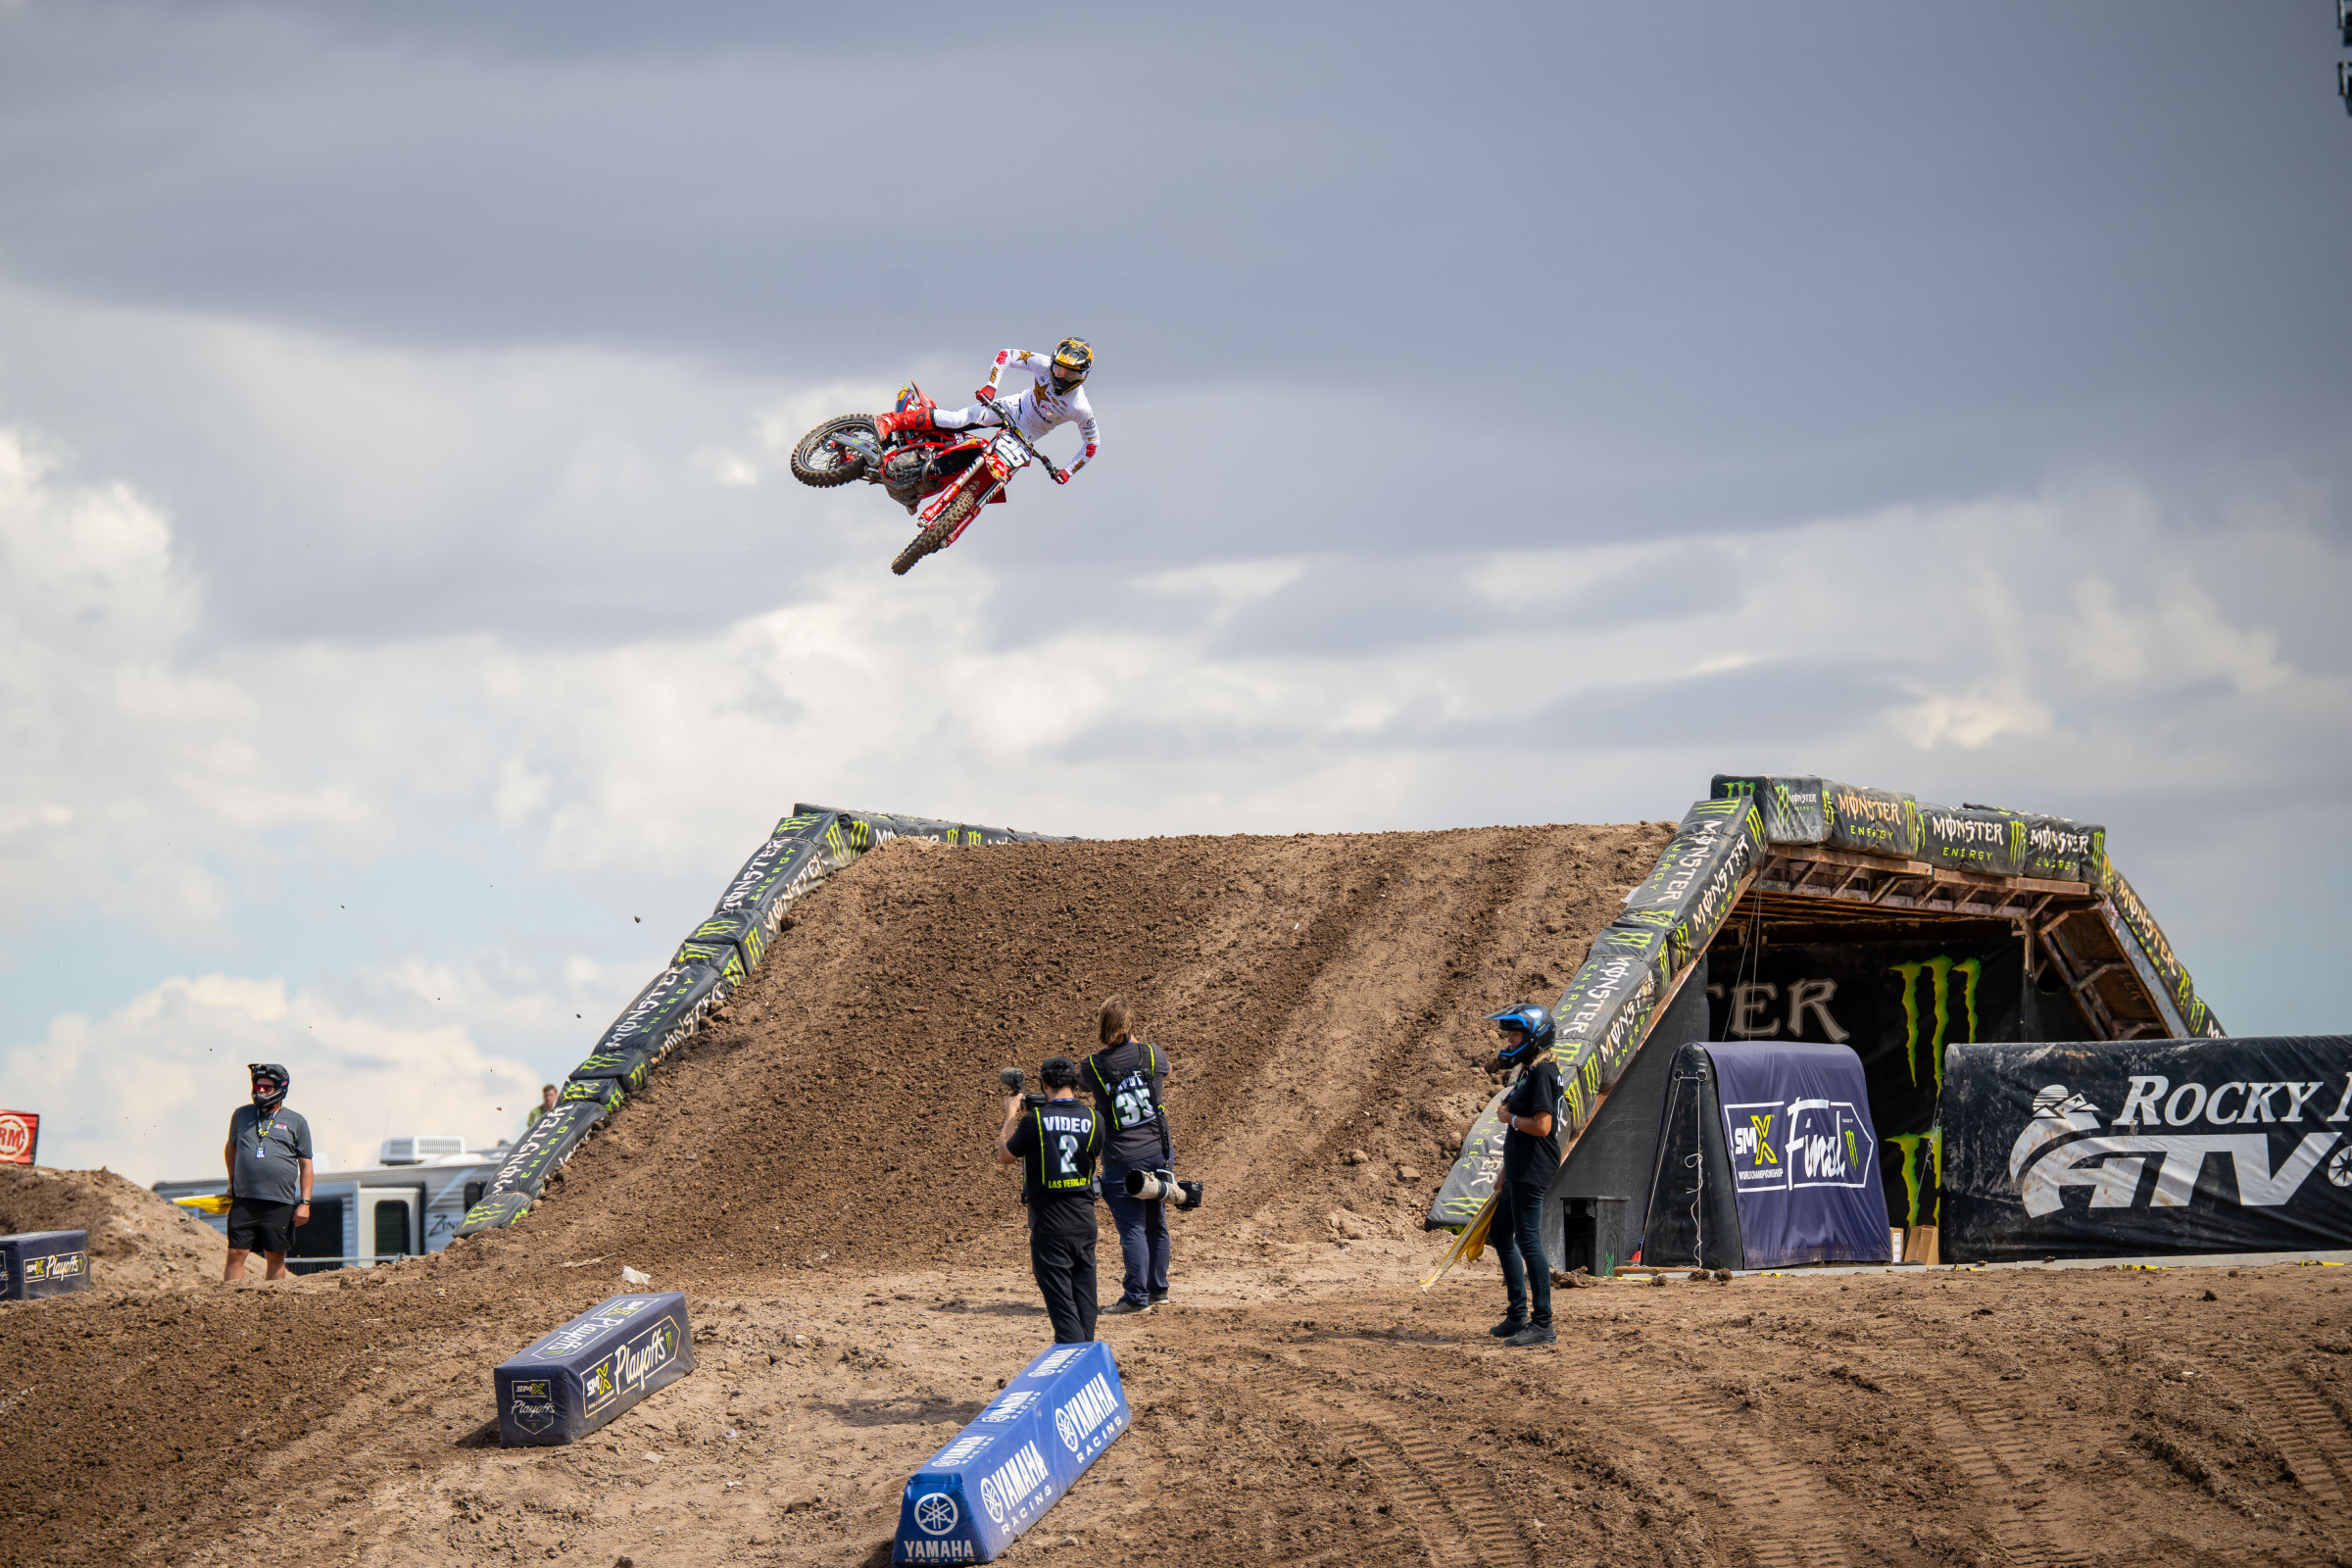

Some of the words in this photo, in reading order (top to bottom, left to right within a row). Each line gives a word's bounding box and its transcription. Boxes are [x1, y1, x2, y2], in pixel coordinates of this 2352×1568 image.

[996, 434, 1031, 467] 25
[1838, 792, 1901, 825] MONSTER
[1932, 813, 2004, 847] MONSTER
[749, 848, 795, 901] ENERGY
[1649, 836, 1690, 890] NERGY
[1942, 847, 1993, 860] ENERGY
[1707, 872, 1742, 935] ENERG
[641, 977, 694, 1033] ENERGY
[1556, 964, 1598, 1020] ENERGY
[1615, 1004, 1650, 1066] ENERGY
[1043, 1115, 1092, 1133] VIDEO
[1115, 1088, 1155, 1126] 35
[2111, 1075, 2325, 1127] ROCKY
[520, 1115, 575, 1179] ENERGY
[1058, 1134, 1078, 1173] 2
[1462, 1108, 1498, 1169] NERGY
[1735, 1114, 1778, 1165] SMX
[1785, 1097, 1846, 1191] Final
[1048, 1180, 1062, 1189] LAS
[46, 1254, 78, 1281] Playoffs
[587, 1361, 612, 1397] SMX
[614, 1328, 666, 1395] Playoffs
[511, 1399, 556, 1418] Playoffs
[515, 1383, 546, 1395] SMX
[1064, 1372, 1119, 1441] YAMAHA
[1077, 1415, 1123, 1464] RACING
[991, 1440, 1050, 1510] YAMAHA
[1002, 1485, 1053, 1536] RACING
[904, 1540, 974, 1558] YAMAHA
